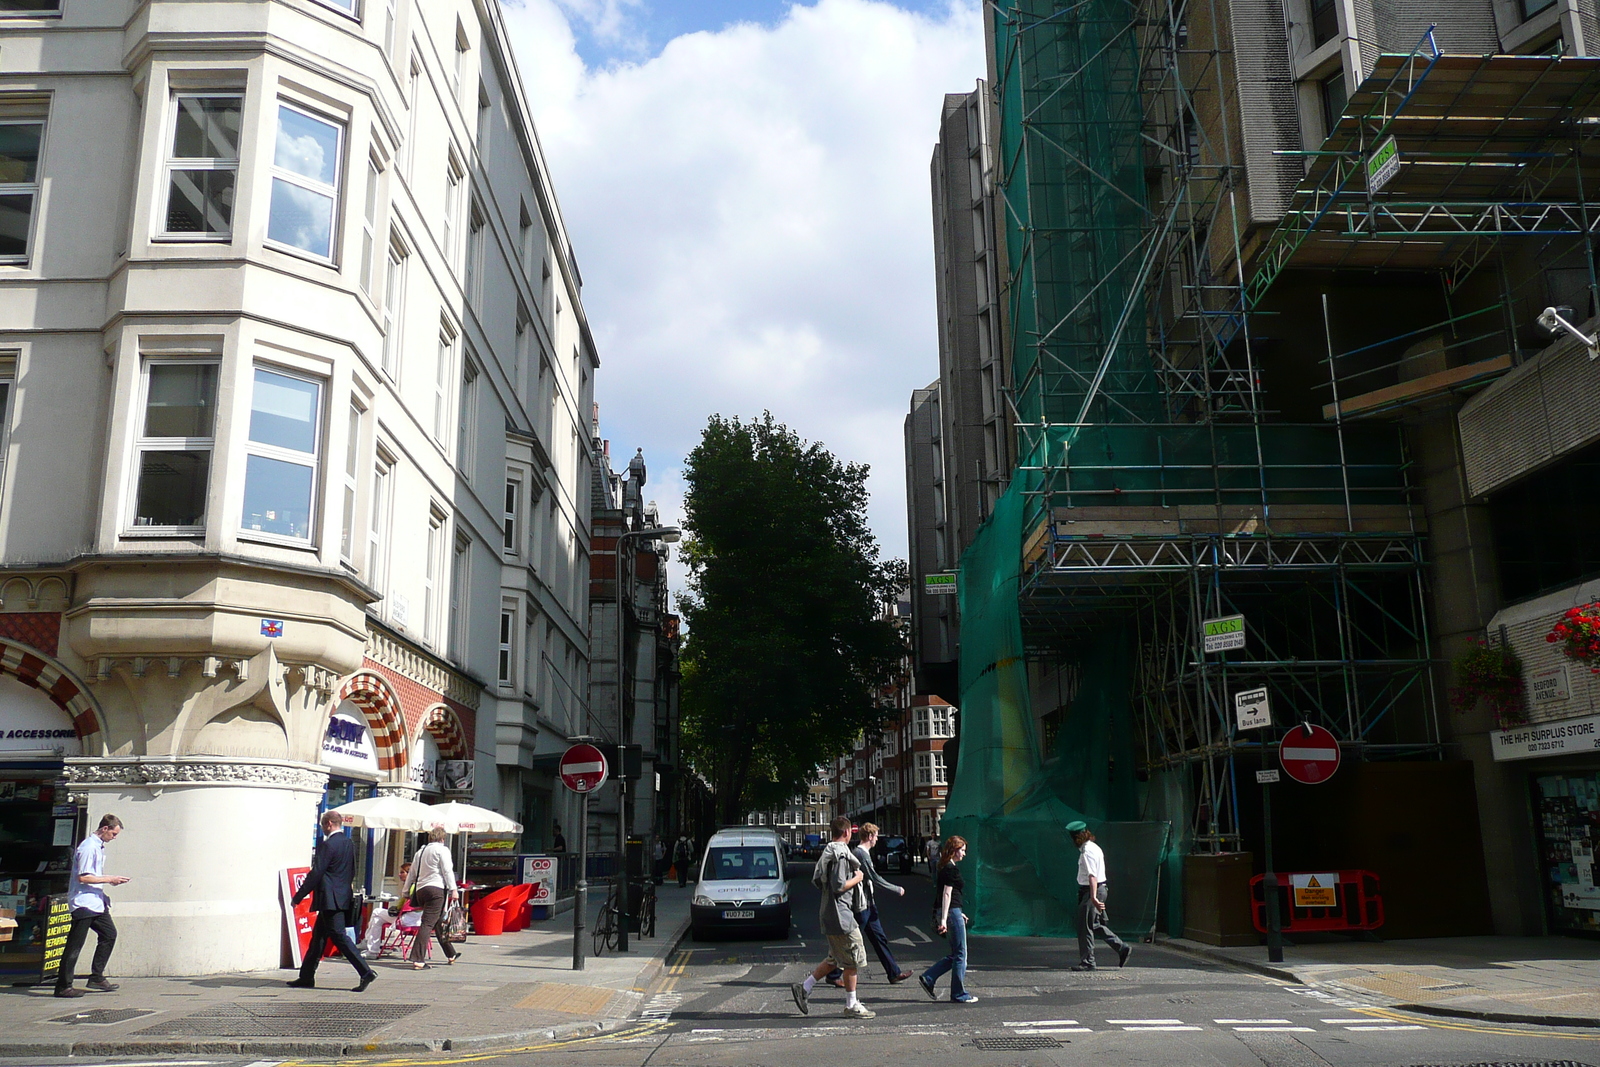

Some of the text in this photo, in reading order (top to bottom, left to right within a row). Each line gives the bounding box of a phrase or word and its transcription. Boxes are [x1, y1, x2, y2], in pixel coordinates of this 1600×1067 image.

[1373, 147, 1390, 174] AGS
[930, 576, 950, 584] AGS
[1211, 620, 1236, 635] AGS
[1206, 633, 1234, 642] SCAFFOLDING
[1534, 678, 1558, 691] BEDFORD
[1536, 688, 1556, 701] AVENUE
[6, 729, 76, 738] ACCESSORIE
[326, 716, 366, 744] SONY
[1500, 723, 1595, 745] THE HI-FI SURPLUS STORE
[1528, 743, 1537, 752] 020
[1538, 742, 1550, 750] 7323
[1551, 740, 1564, 749] 6712
